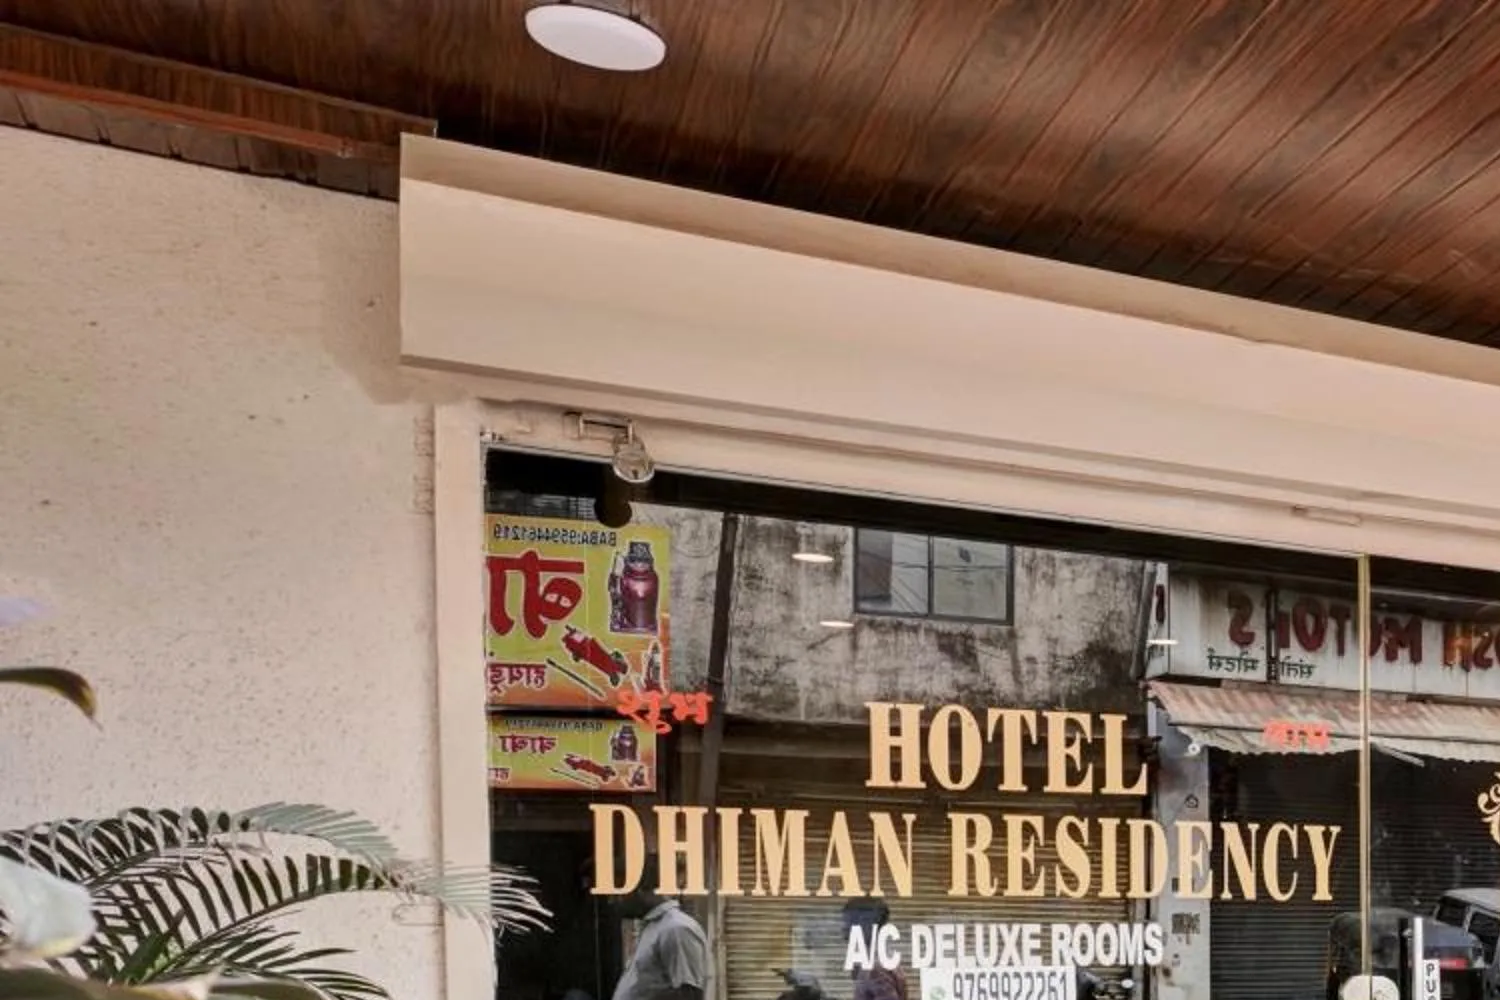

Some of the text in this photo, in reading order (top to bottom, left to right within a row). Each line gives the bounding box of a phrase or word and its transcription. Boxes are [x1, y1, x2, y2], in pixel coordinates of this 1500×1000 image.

[865, 702, 1149, 796] HOTEL
[590, 803, 1341, 902] DHIMAN RESIDENCY
[844, 922, 1164, 972] A/C DELUXE ROOMS
